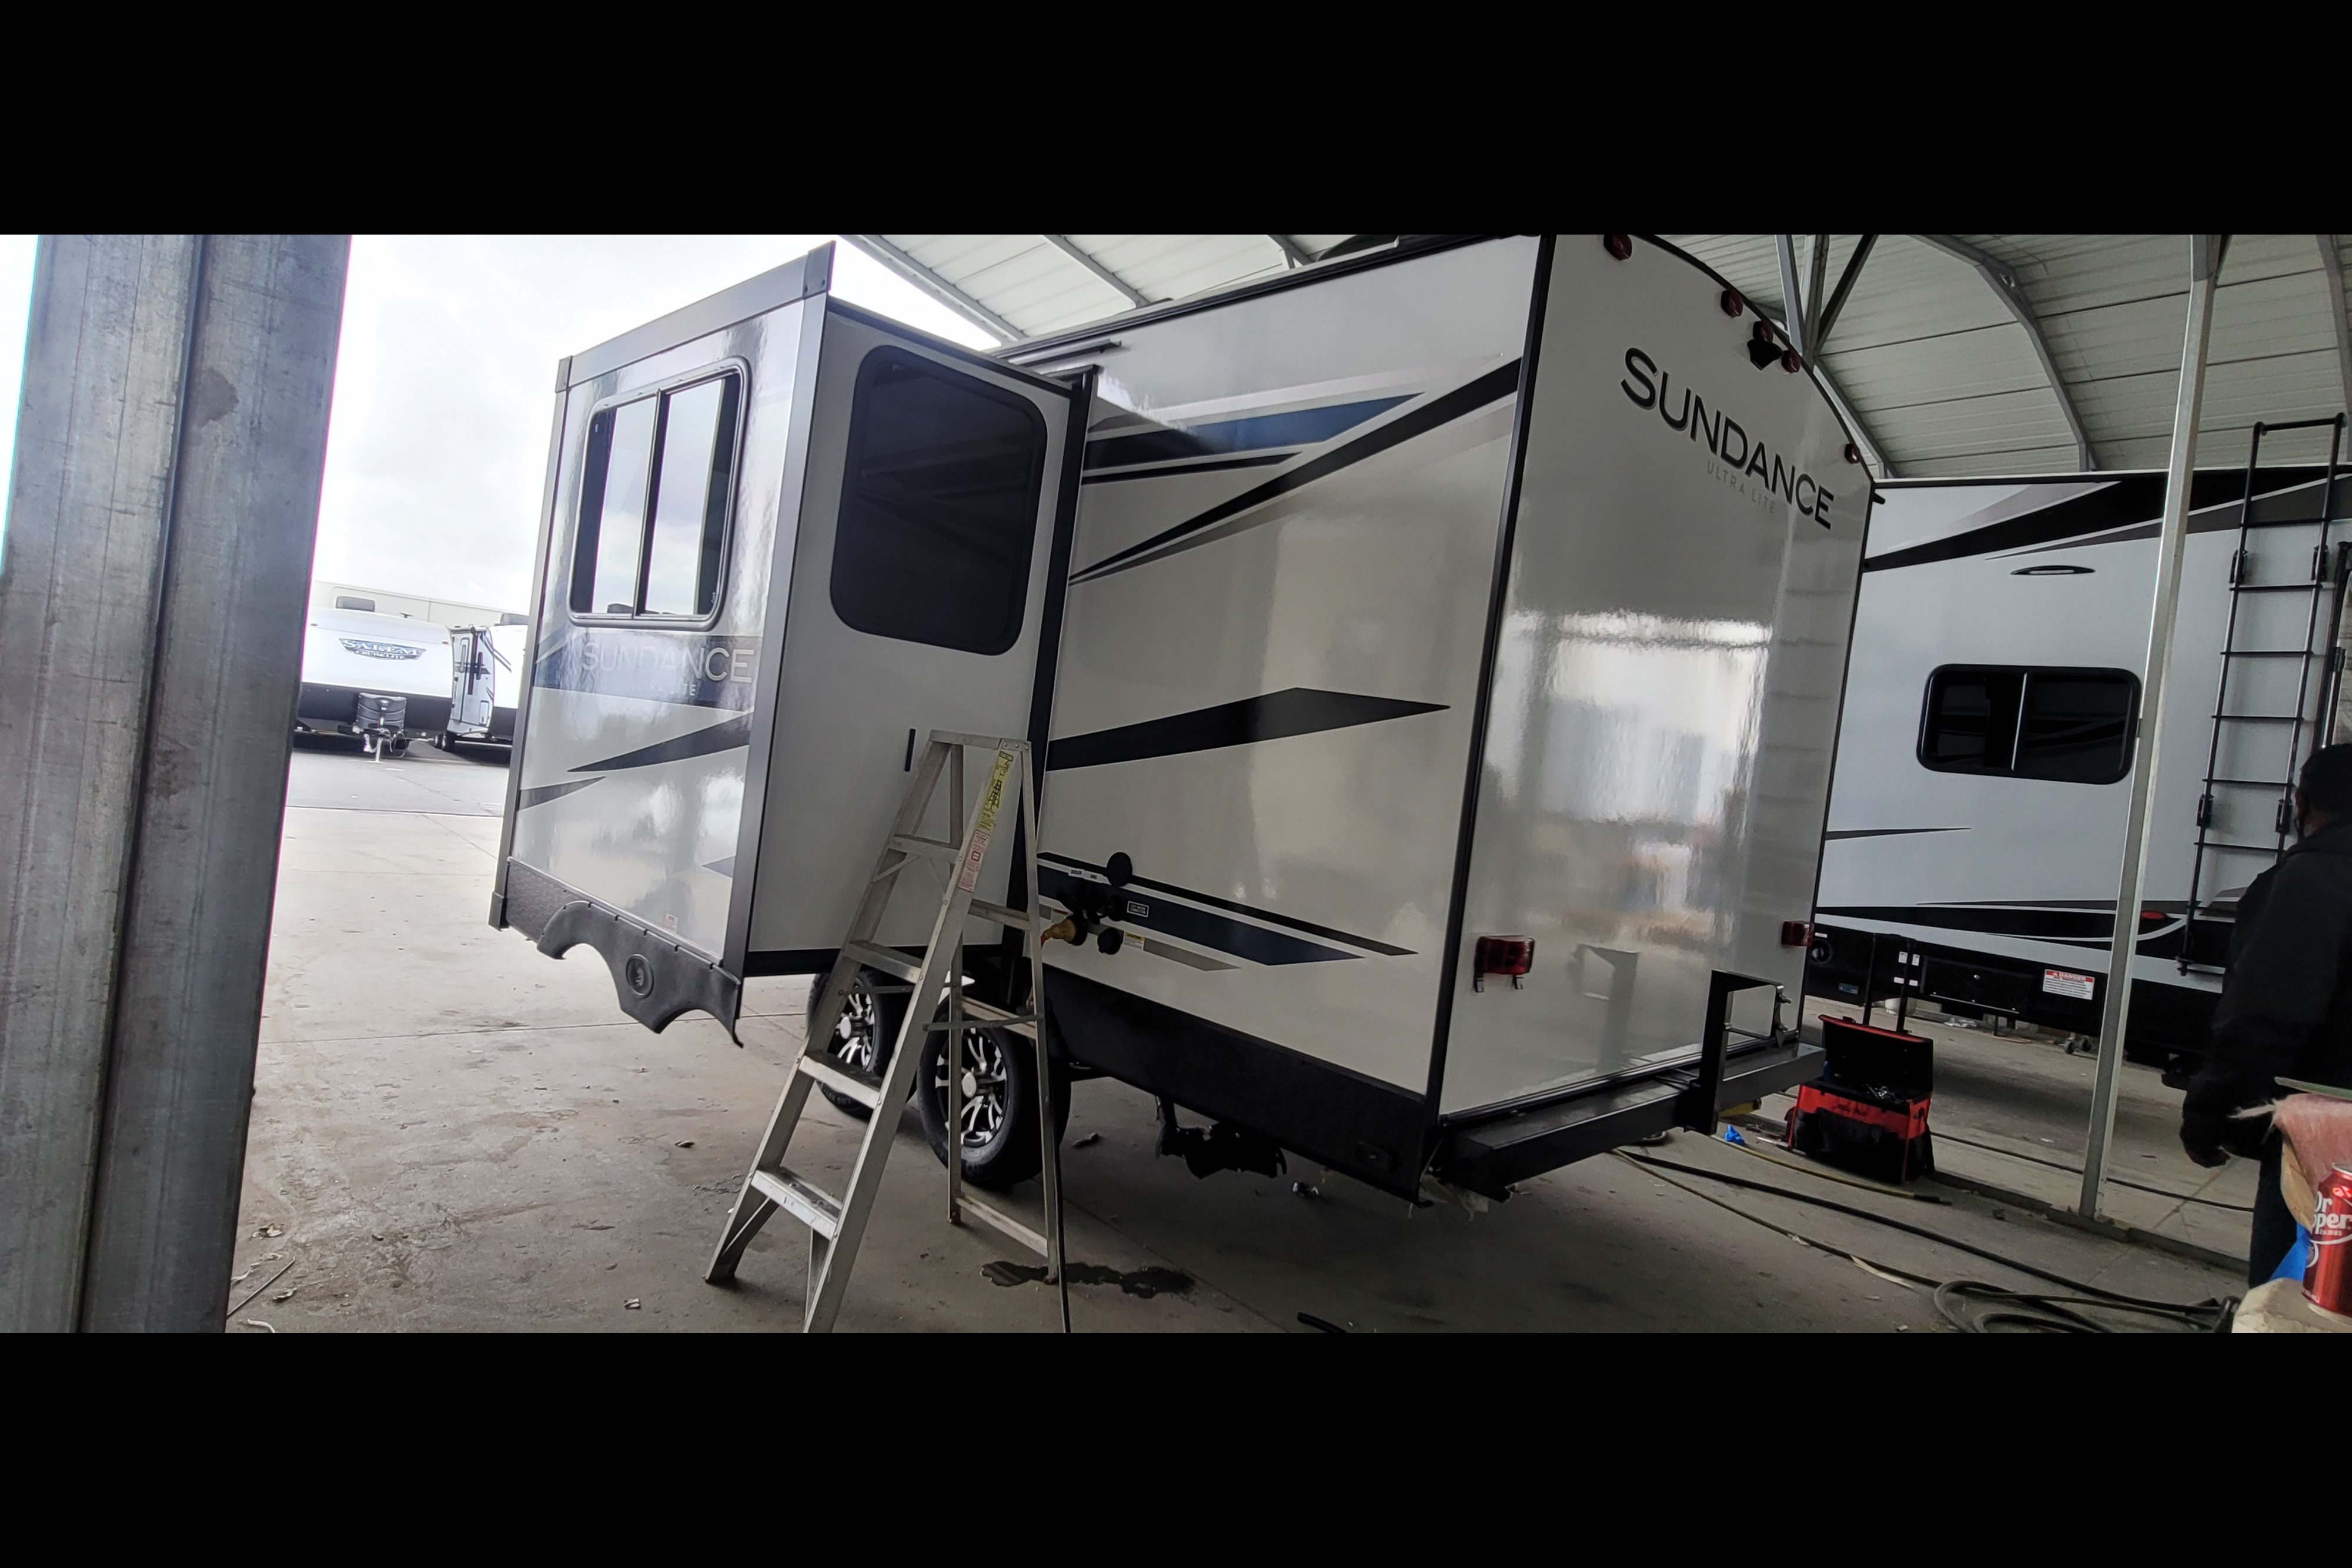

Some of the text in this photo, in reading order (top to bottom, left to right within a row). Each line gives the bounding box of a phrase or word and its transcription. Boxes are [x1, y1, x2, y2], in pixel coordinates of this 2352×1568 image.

[1621, 347, 1834, 530] SUNDANCE
[1707, 459, 1776, 514] ULTRA LITE
[344, 640, 419, 656] SALEM
[580, 641, 755, 683] SUNDANCE
